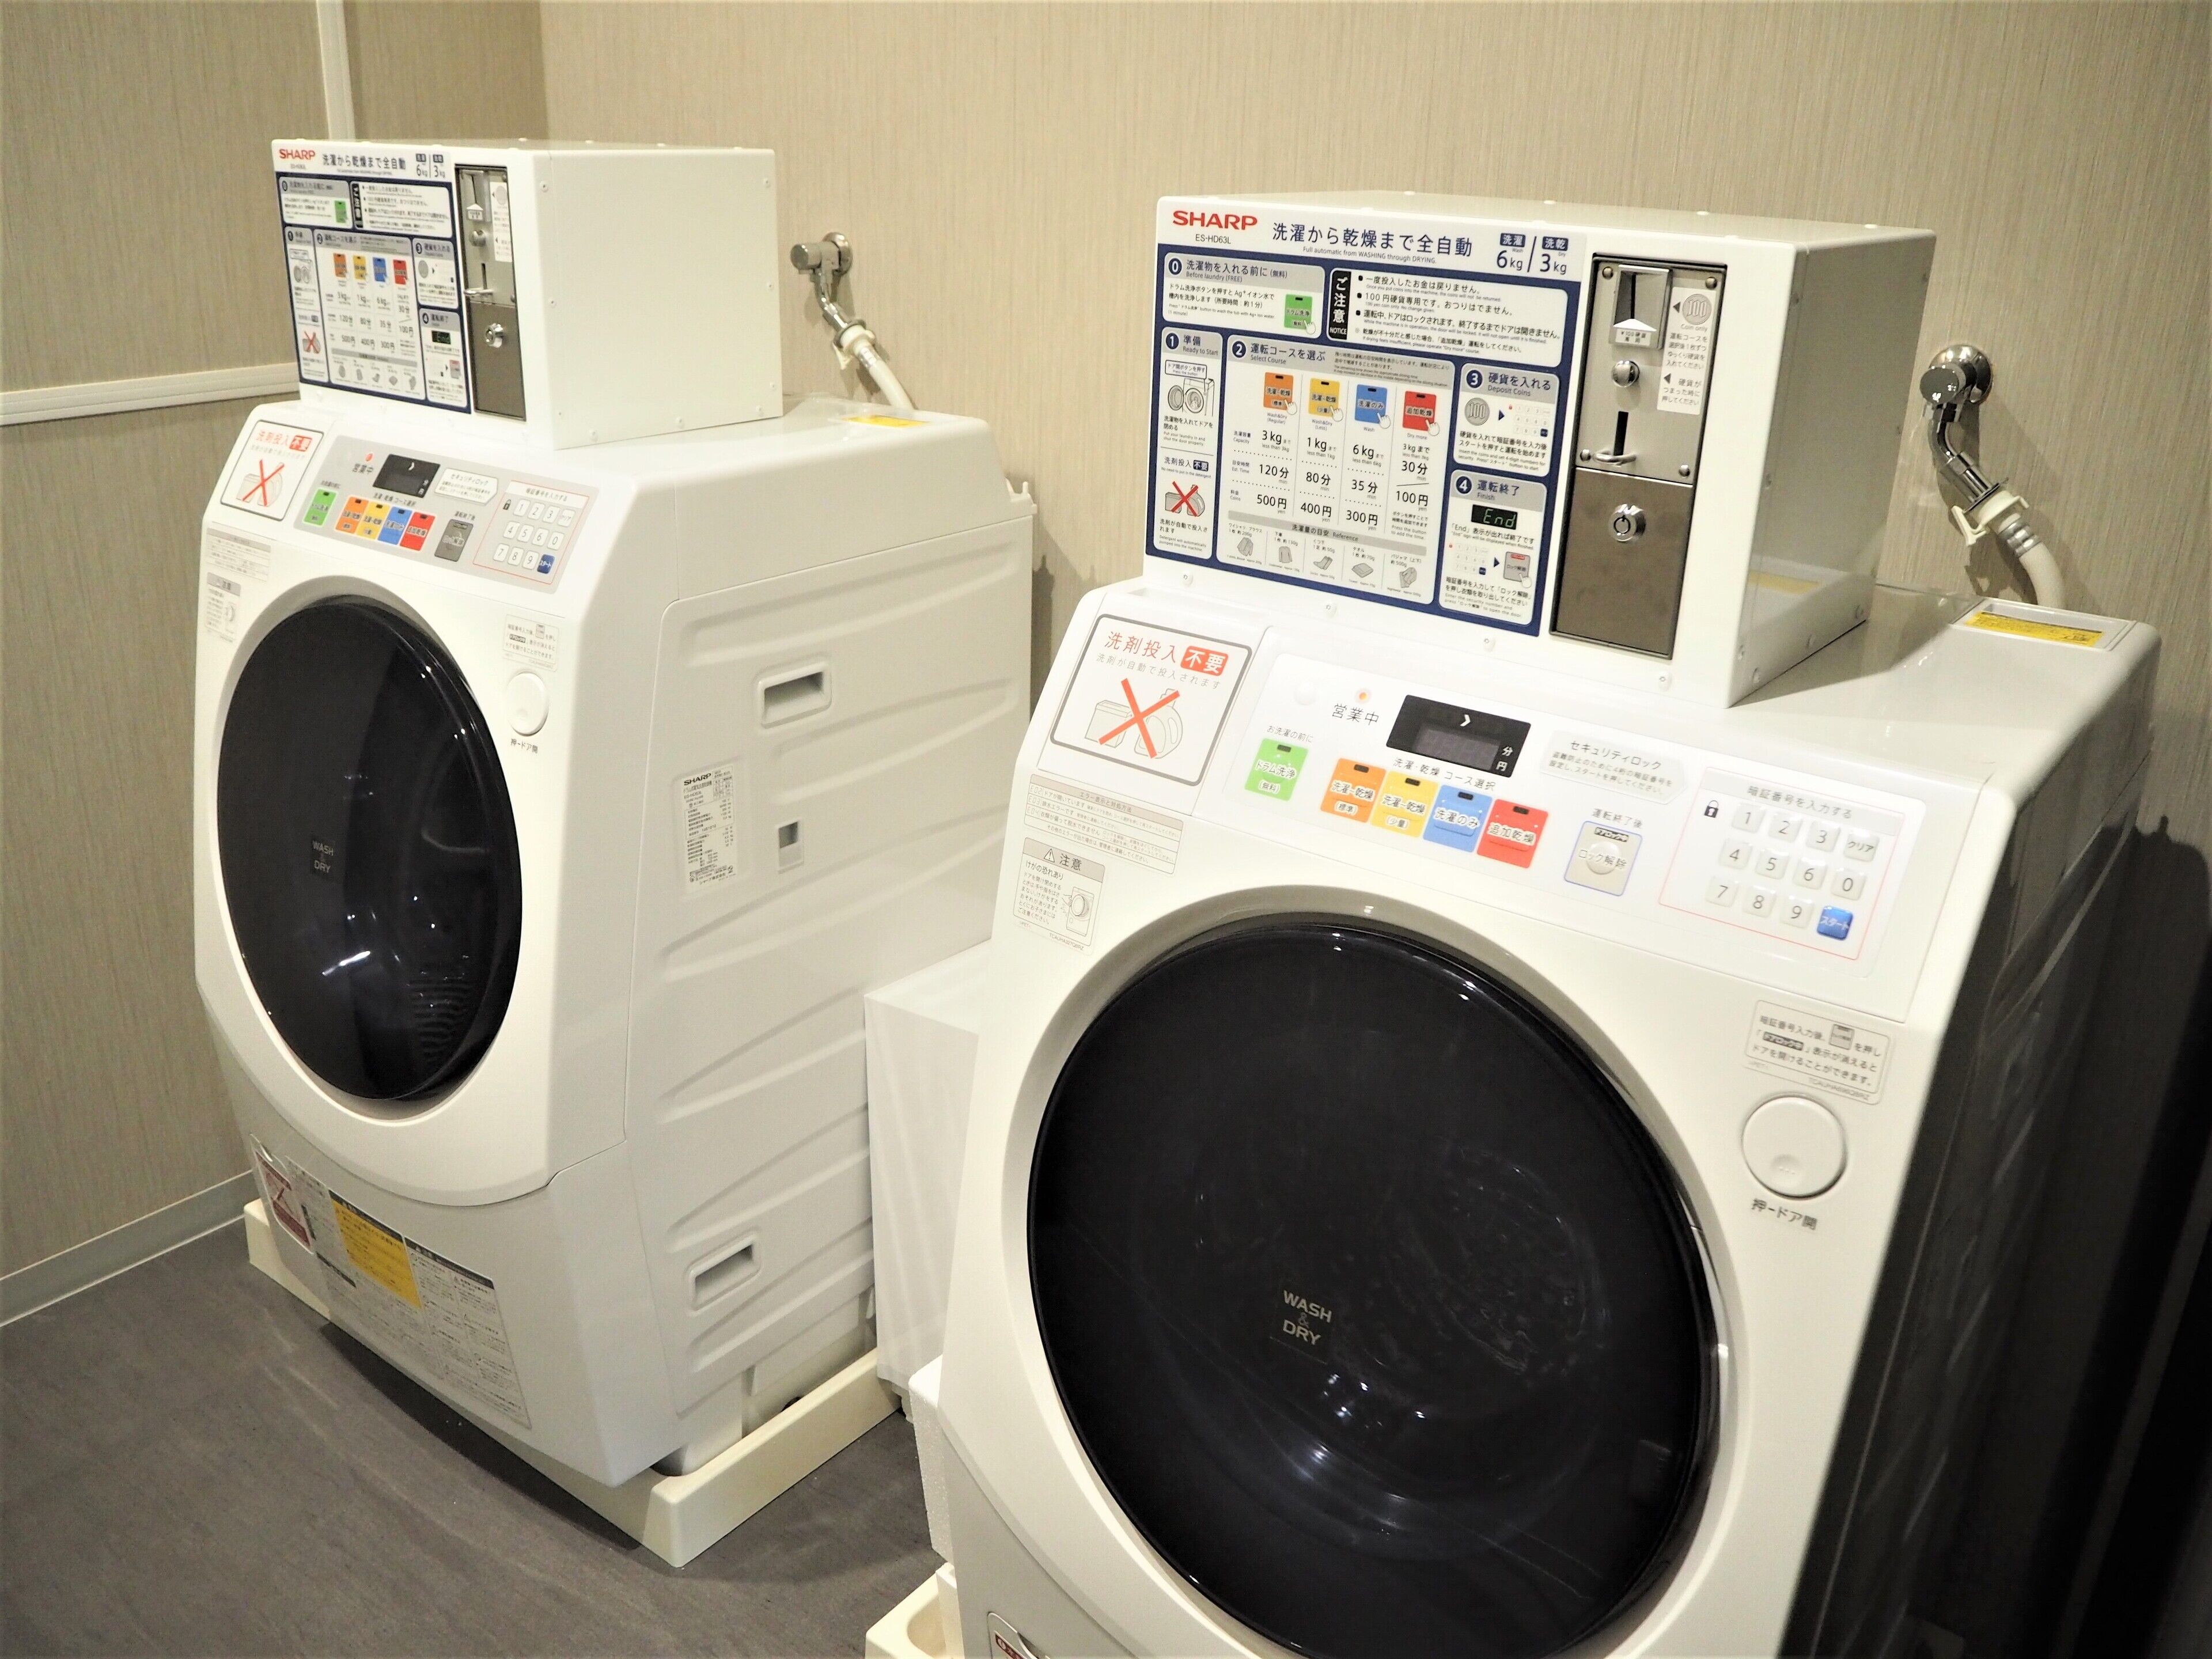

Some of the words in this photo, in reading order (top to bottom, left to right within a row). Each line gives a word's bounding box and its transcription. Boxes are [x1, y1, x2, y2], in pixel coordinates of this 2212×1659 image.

[279, 149, 315, 160] SHARP
[1173, 210, 1257, 230] SHARP
[1195, 234, 1232, 244] ES-HD63L
[1272, 222, 1472, 257] 洗濯から乾燥まで全自動
[1502, 234, 1525, 247] 洗濯
[1314, 248, 1341, 256] automatic
[1358, 252, 1386, 260] WASHING
[1387, 253, 1411, 263] through
[1412, 255, 1437, 264] DRYING.
[1187, 260, 1267, 277] 洗濯物を入れる前に
[1205, 274, 1225, 282] laundry
[1333, 276, 1347, 323] ご注意
[1183, 334, 1201, 346] 準備
[1183, 346, 1199, 355] Ready
[1251, 343, 1326, 361] 運転コースを選ぶ
[1488, 372, 1551, 391] 硬貨を入れる
[1487, 385, 1512, 395] Deposit
[1513, 388, 1531, 397] Coins
[1164, 456, 1191, 468] 洗剤投入
[1402, 460, 1428, 475] 30分
[1259, 464, 1289, 479] 120分
[1306, 472, 1331, 486] 80分
[1351, 479, 1378, 494] 35分
[1477, 480, 1520, 496] 運転終了
[1256, 494, 1287, 510] 500円
[1396, 490, 1429, 507] 100円
[1477, 492, 1495, 501] Finish
[1301, 502, 1332, 518] 400円
[1346, 510, 1378, 526] 300円
[1483, 508, 1517, 529] End
[1332, 532, 1358, 542] Reference
[1104, 631, 1177, 664] 洗剤投入
[1185, 647, 1226, 674] 不要
[1096, 652, 1222, 690] 洗剤が自動で投入されます
[1332, 703, 1379, 726] 営業中
[1267, 725, 1314, 743] お洗濯の前に
[1502, 746, 1514, 756] 分
[1570, 740, 1661, 770] セキュリティロック
[1256, 760, 1296, 779] ドラム洗浄
[1495, 761, 1508, 772] 円
[684, 772, 712, 786] SHARP
[1444, 771, 1497, 791] コース選択
[1747, 785, 1852, 820] 暗証番号を入力する
[1434, 809, 1478, 829] 洗濯のみ
[1592, 808, 1643, 830] 運転終了後
[1490, 824, 1535, 844] 追加乾燥
[1745, 812, 1751, 825] 1
[1778, 820, 1790, 835] 2
[1816, 830, 1827, 844] 3
[1848, 840, 1874, 854] クリア
[1059, 853, 1082, 872] 注意
[1578, 849, 1627, 870] ロック解除
[1729, 849, 1740, 862] 4
[1766, 857, 1777, 871] 5
[1804, 868, 1815, 881] 6
[1842, 877, 1854, 892] 0
[1718, 885, 1728, 899] 7
[1753, 895, 1765, 909] 8
[1791, 906, 1802, 919] 9
[1283, 1290, 1332, 1323] WASH
[1283, 1319, 1321, 1345] DRY
